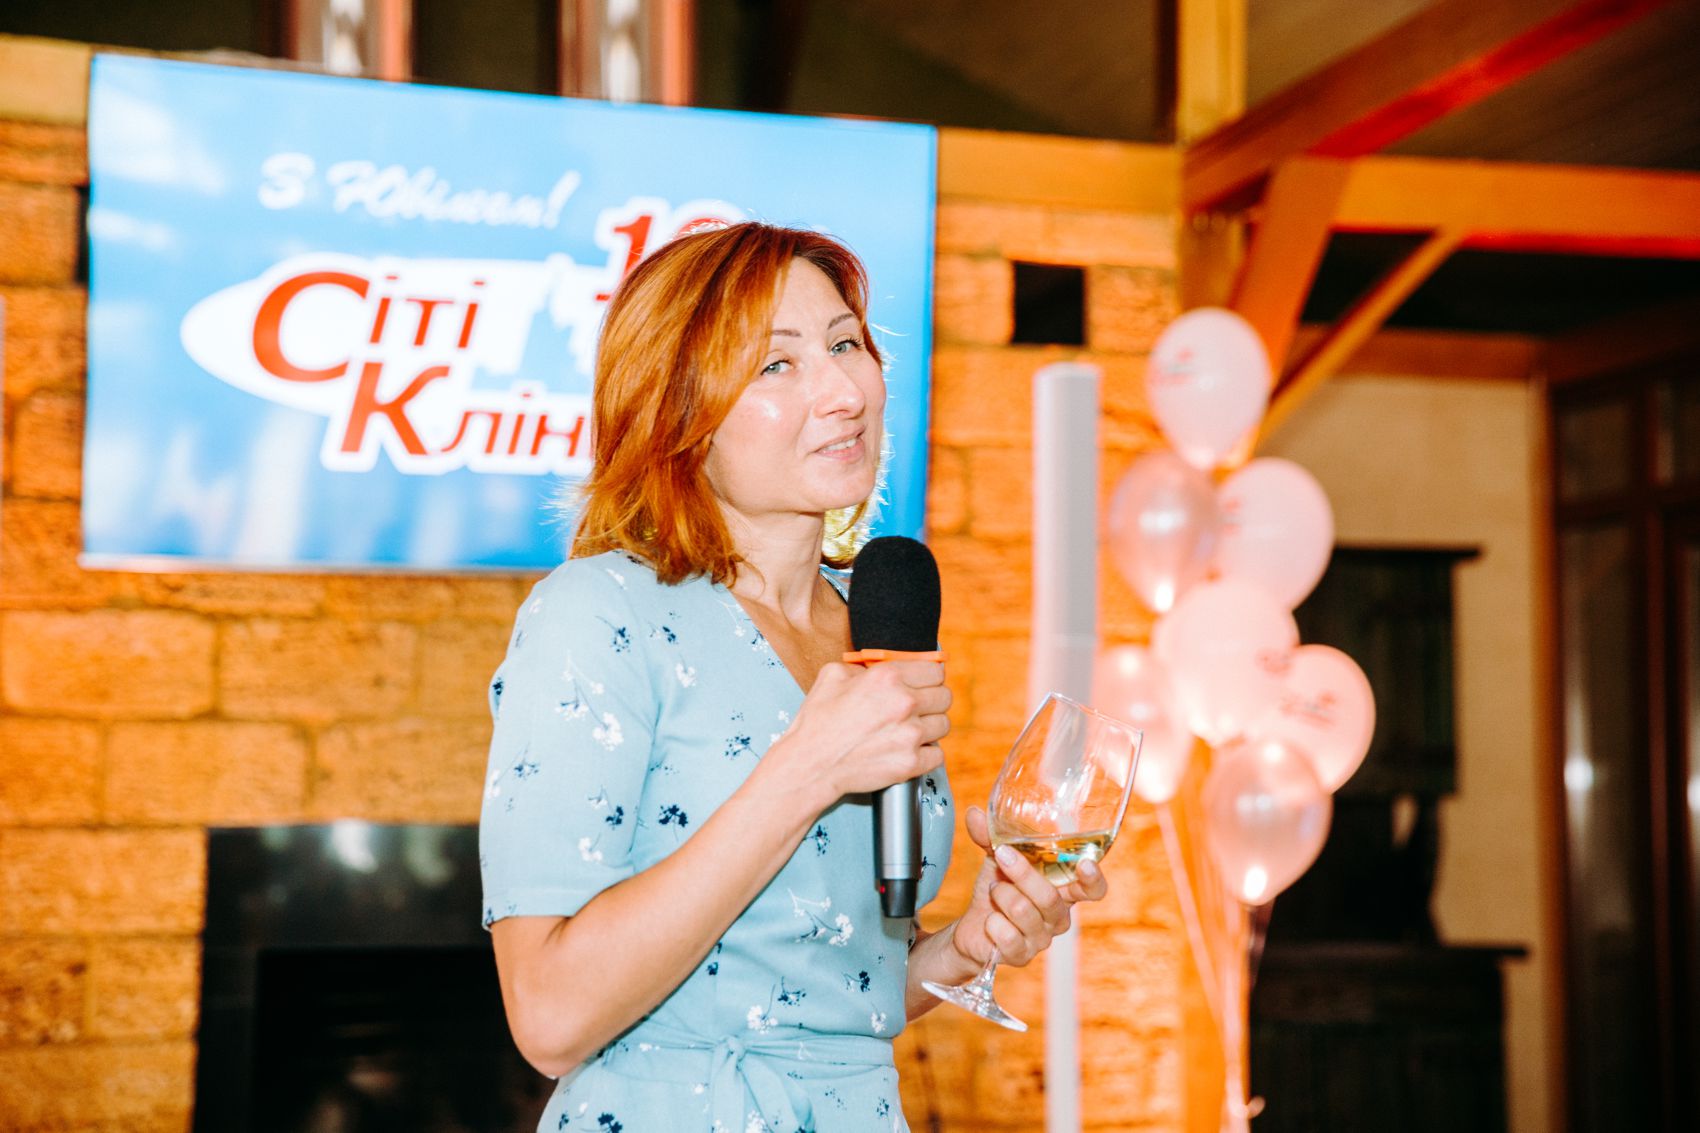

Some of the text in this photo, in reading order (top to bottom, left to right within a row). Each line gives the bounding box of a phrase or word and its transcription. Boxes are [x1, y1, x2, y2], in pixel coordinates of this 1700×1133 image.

[257, 152, 316, 210] З
[596, 215, 730, 302] 1
[252, 271, 485, 383] Сіті
[340, 362, 596, 458] Клін
